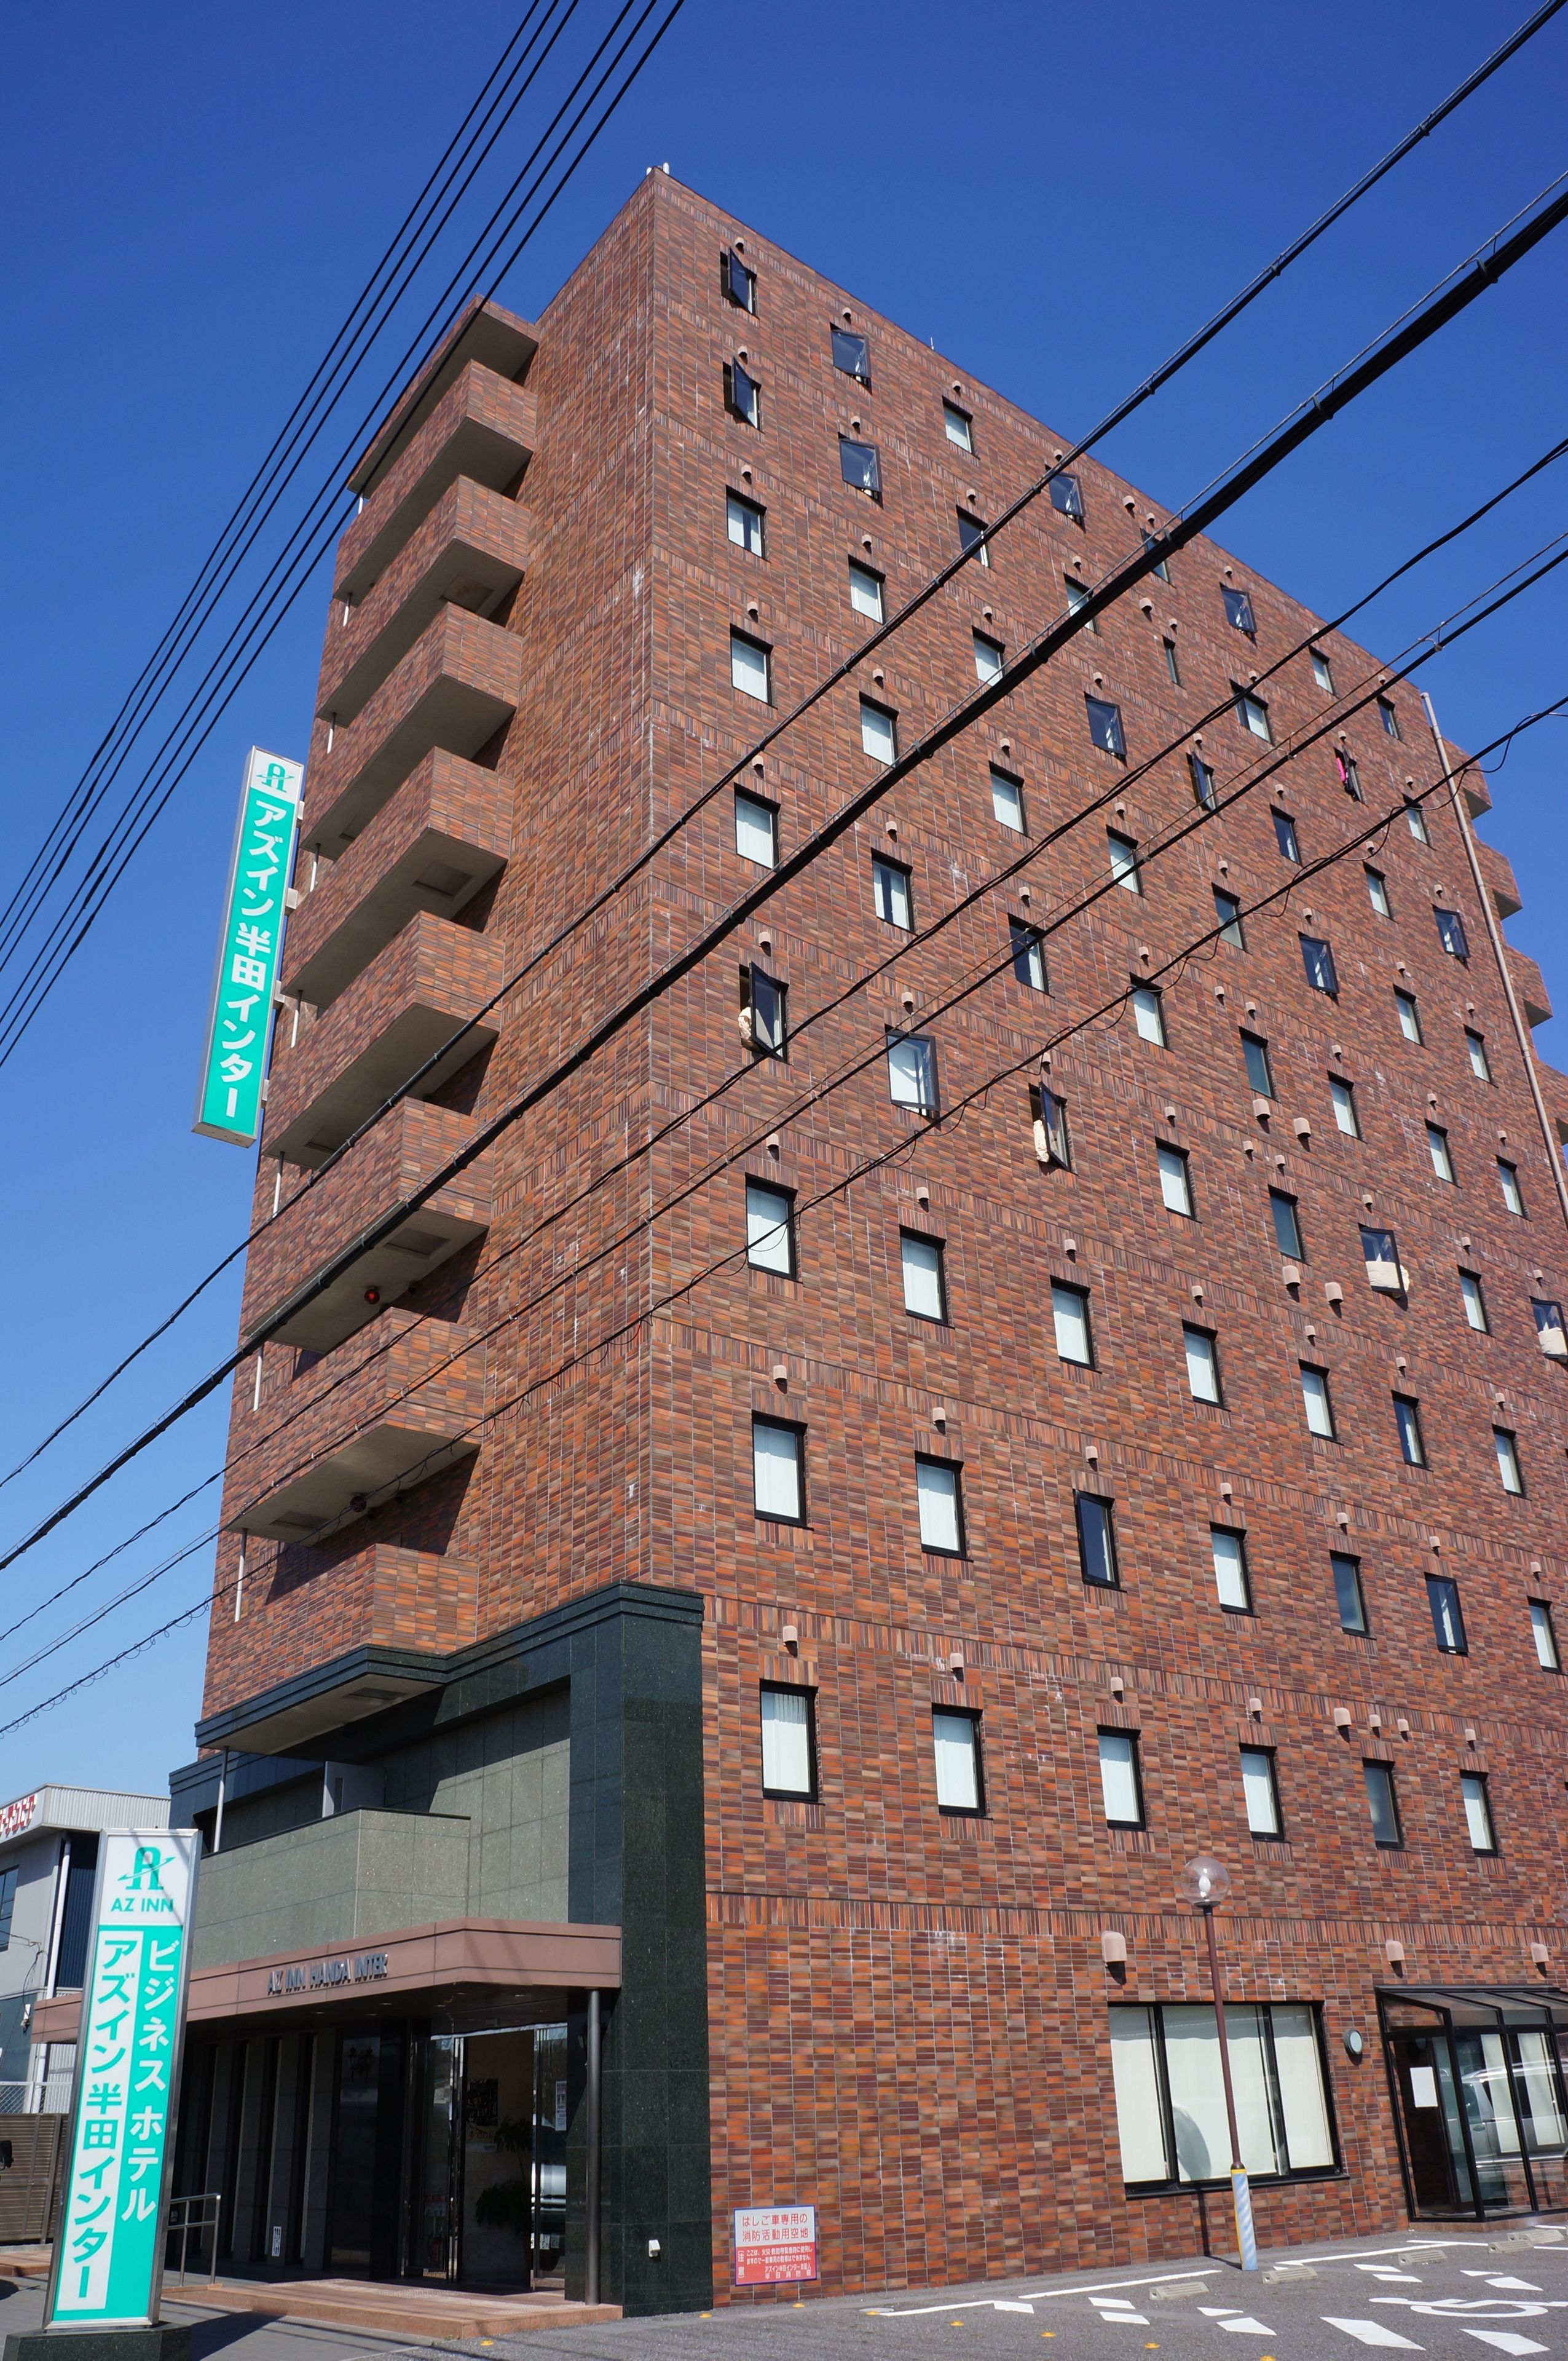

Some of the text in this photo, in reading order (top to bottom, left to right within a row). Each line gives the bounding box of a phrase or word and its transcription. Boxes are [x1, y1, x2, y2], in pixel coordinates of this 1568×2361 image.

[219, 799, 287, 1118] アズイン半田インター
[111, 1897, 174, 1912] AZ INN
[267, 1952, 388, 1994] AZ INN HANDA INTER
[72, 1939, 137, 2298] アズイン半田インター
[742, 2213, 808, 2227] はしご車専用の
[743, 2228, 808, 2242] 消防活動用空地
